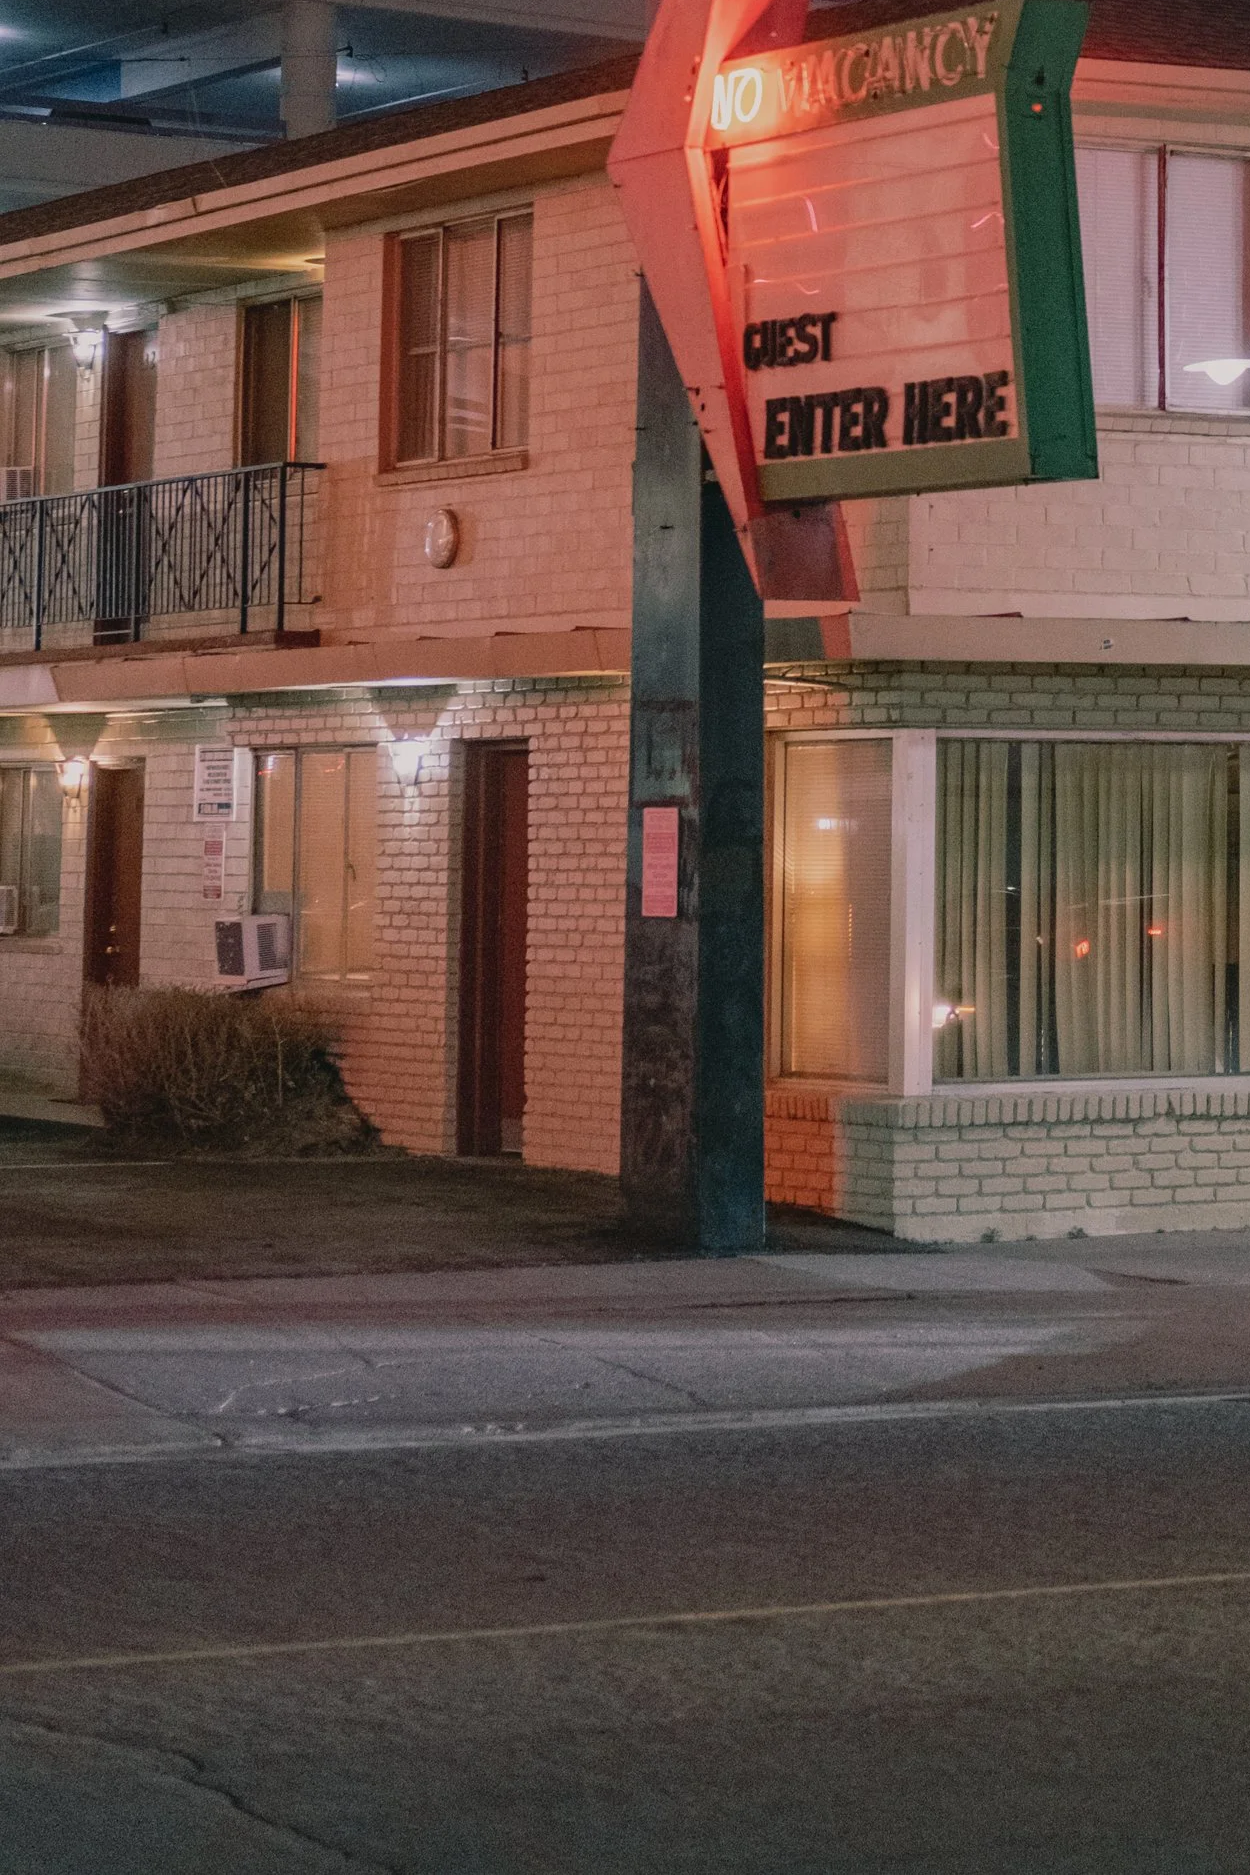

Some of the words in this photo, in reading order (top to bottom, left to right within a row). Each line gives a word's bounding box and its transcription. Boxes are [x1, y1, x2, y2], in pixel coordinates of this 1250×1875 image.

[711, 67, 763, 131] NO
[776, 11, 998, 117] VACANCY
[742, 310, 839, 372] GUEST
[763, 385, 891, 460] ENTER
[902, 369, 1010, 447] HERE
